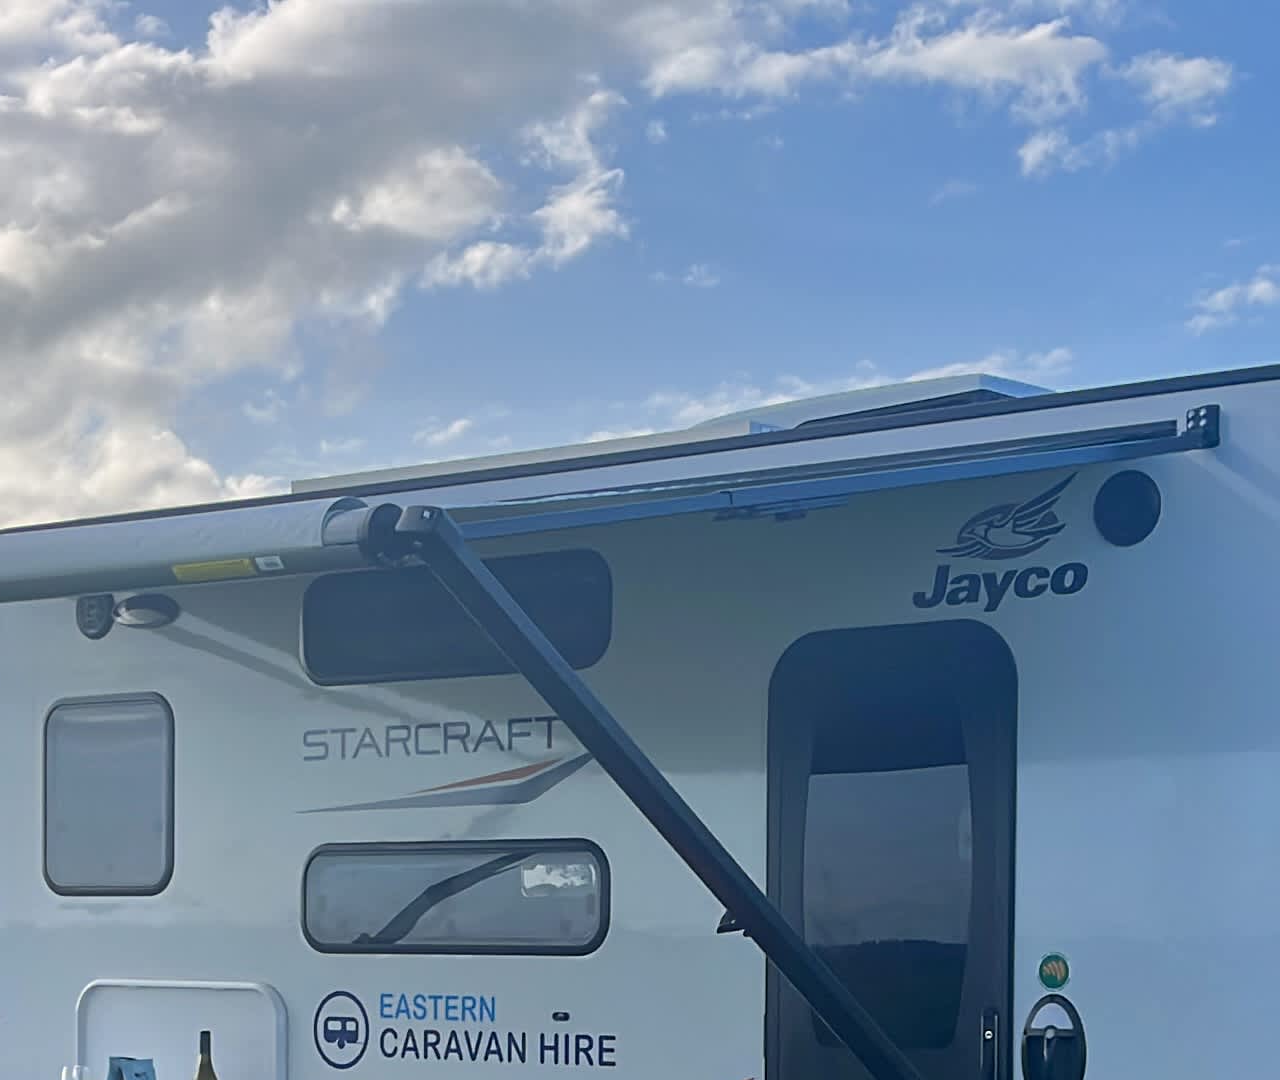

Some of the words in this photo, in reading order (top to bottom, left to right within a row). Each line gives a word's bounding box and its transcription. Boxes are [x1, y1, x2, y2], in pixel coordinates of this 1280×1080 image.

[912, 561, 1089, 613] Jayco
[302, 715, 560, 762] STARCRAFT
[379, 993, 497, 1023] EASTERN
[379, 1027, 527, 1064] CARAVAN
[539, 1032, 617, 1067] HIRE
